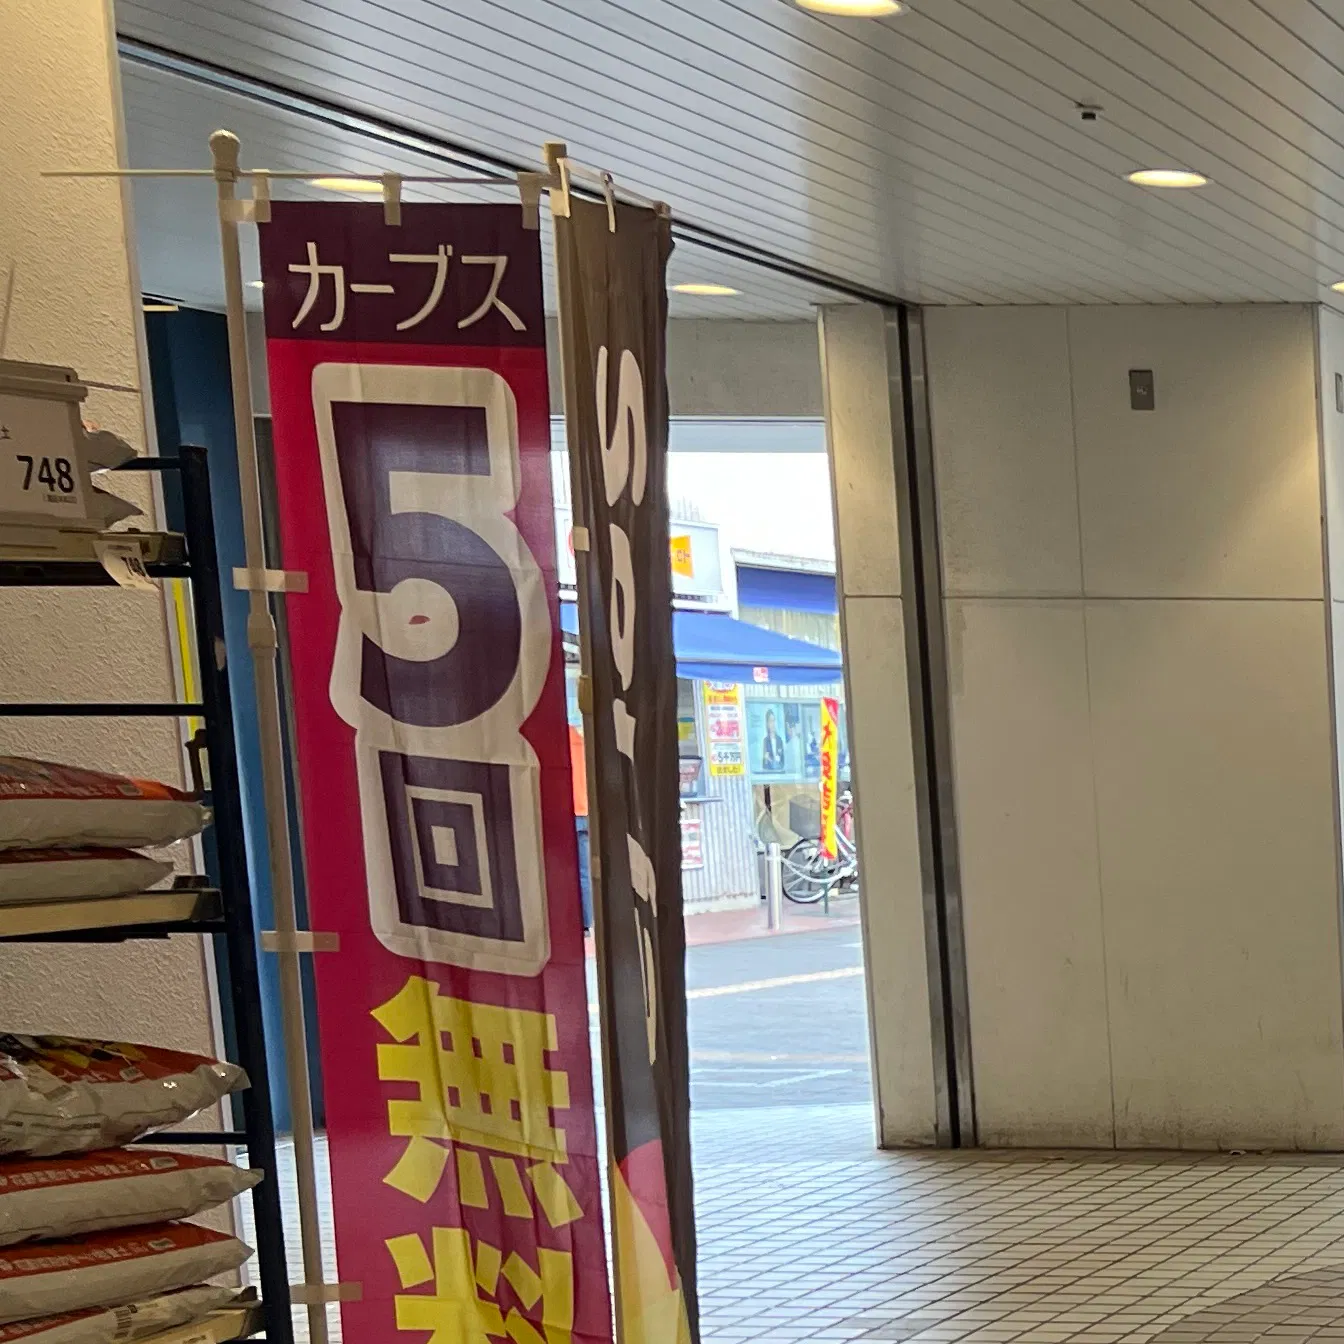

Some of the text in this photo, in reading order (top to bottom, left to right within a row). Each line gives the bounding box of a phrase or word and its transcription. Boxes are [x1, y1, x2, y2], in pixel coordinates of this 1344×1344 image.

[287, 241, 528, 332] カーブス
[16, 455, 75, 494] 748
